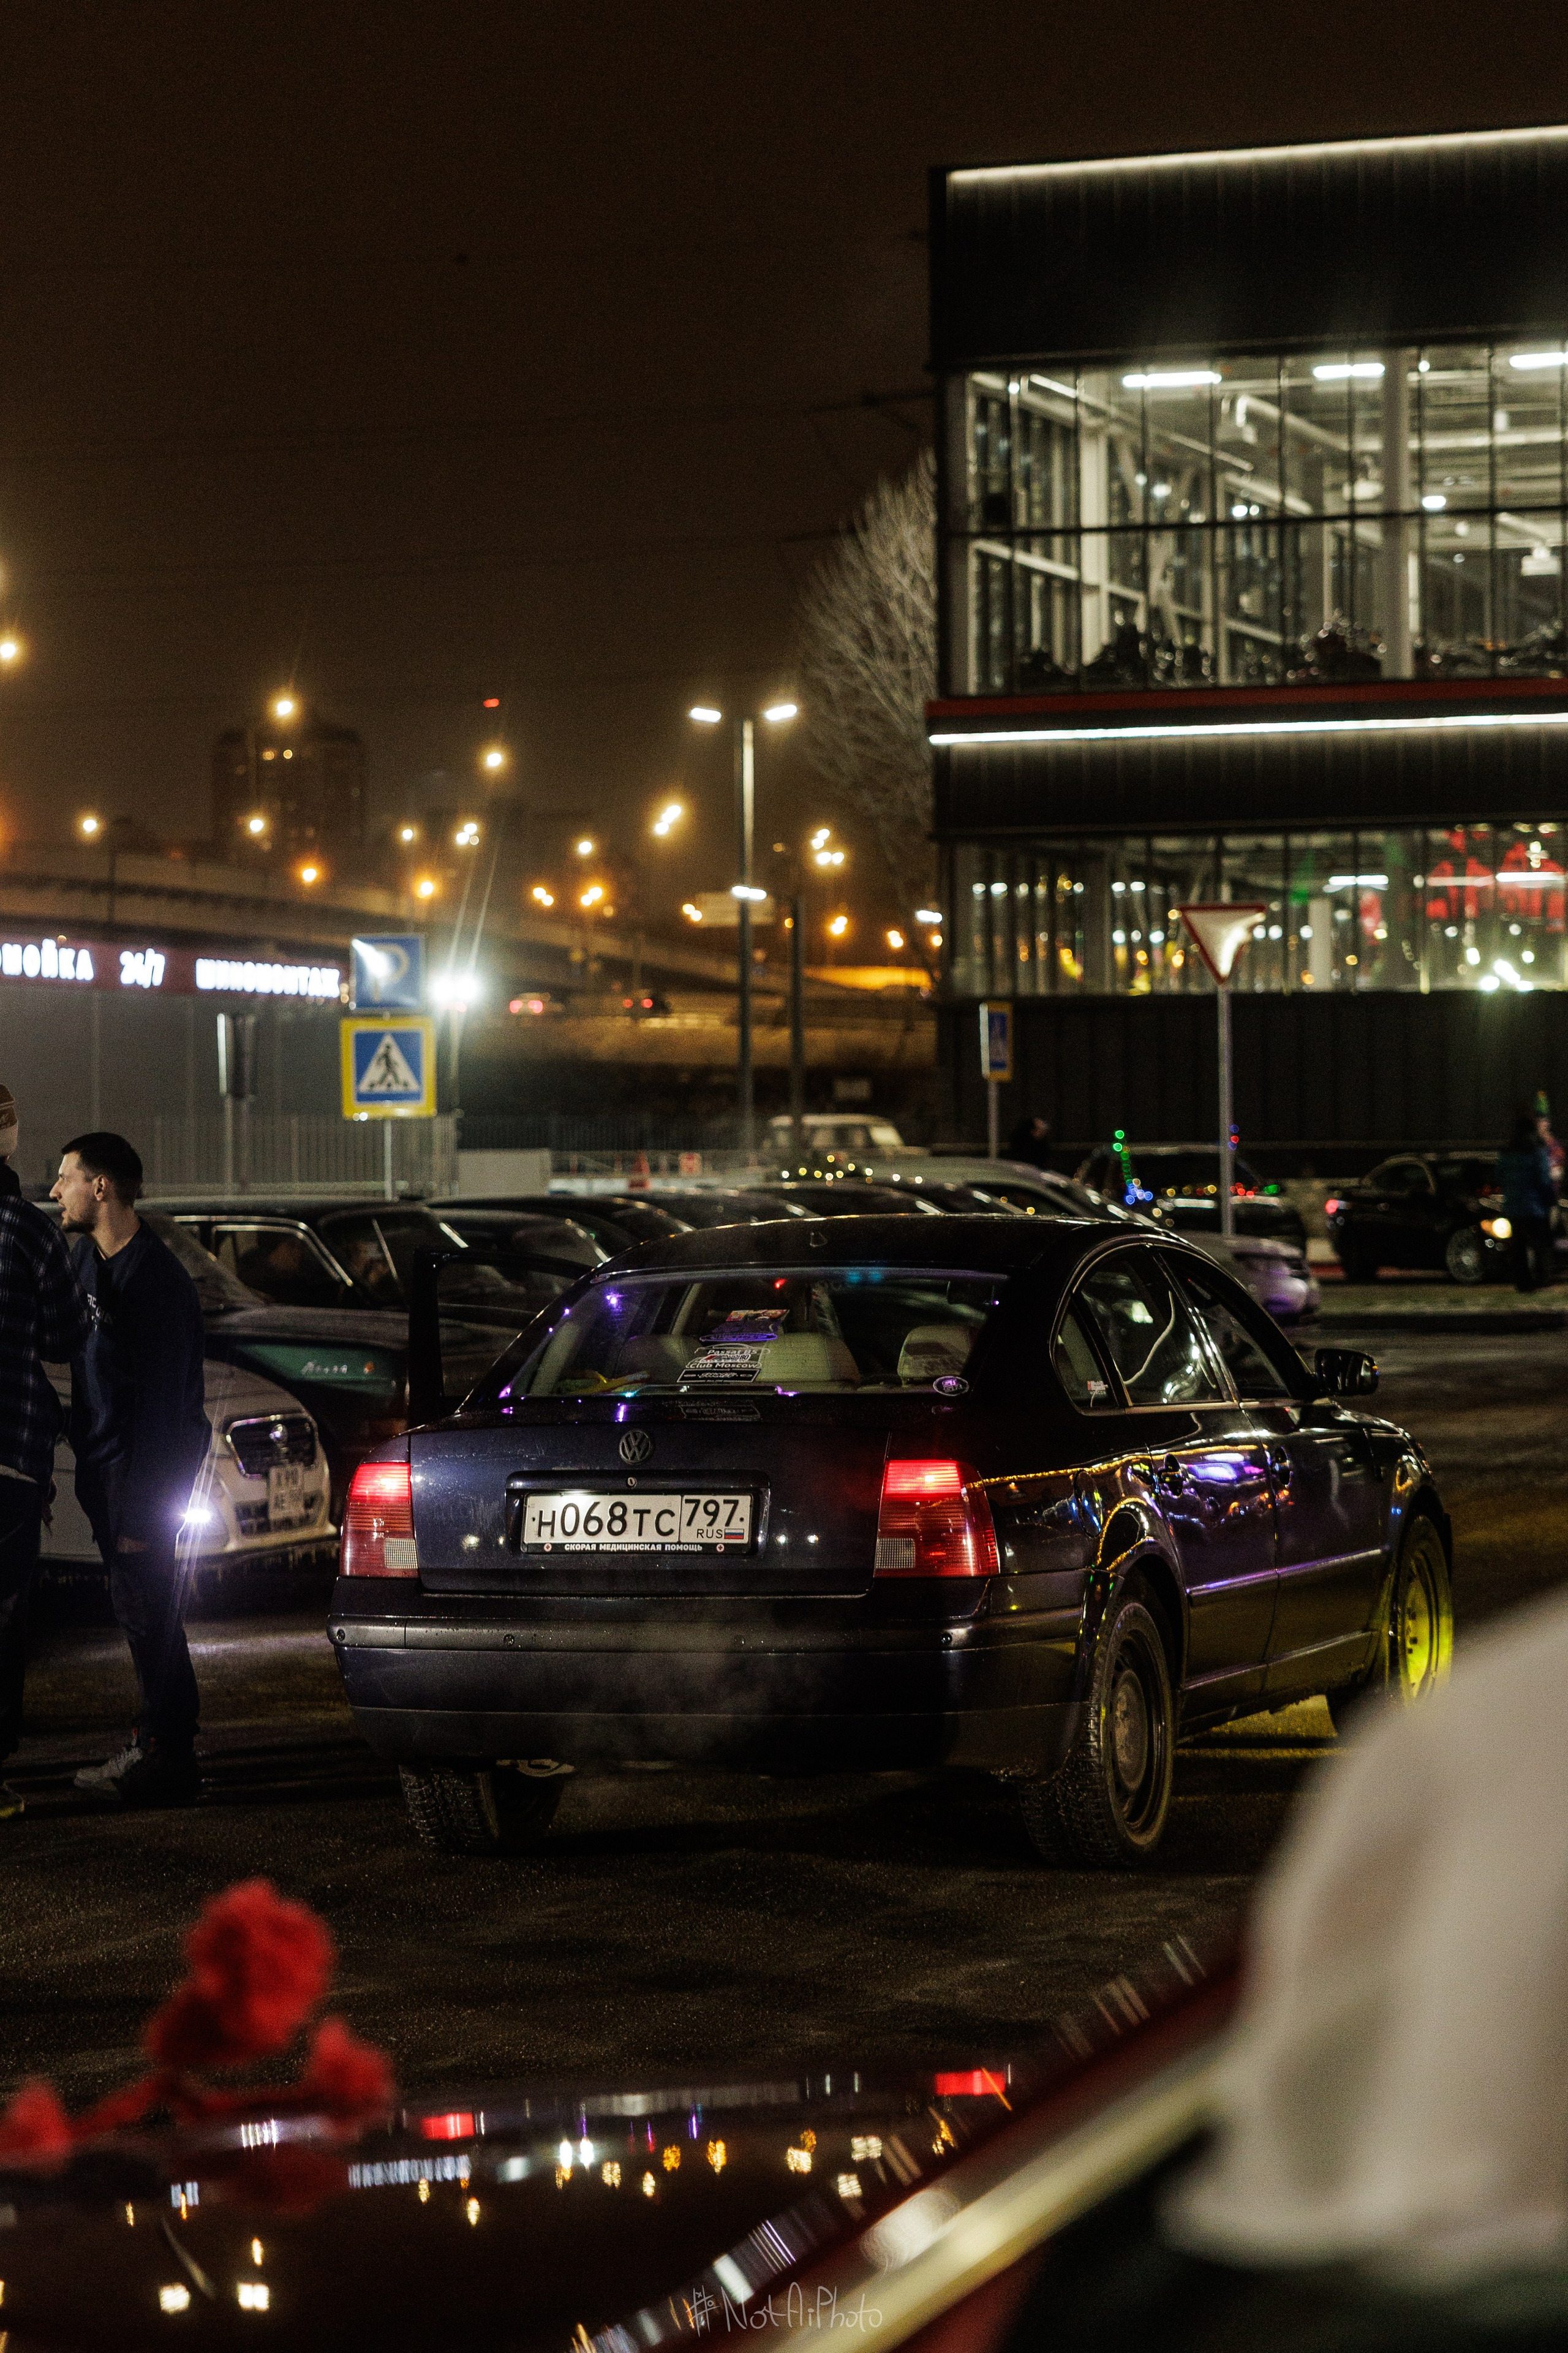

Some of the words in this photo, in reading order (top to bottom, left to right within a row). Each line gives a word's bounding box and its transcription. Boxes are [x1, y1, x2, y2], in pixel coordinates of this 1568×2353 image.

[684, 1498, 740, 1527] 797
[696, 1528, 723, 1538] RUS
[599, 1544, 662, 1552] МЕДИЦИНСКАЯ
[665, 1543, 703, 1552] ПОМОЩЬ
